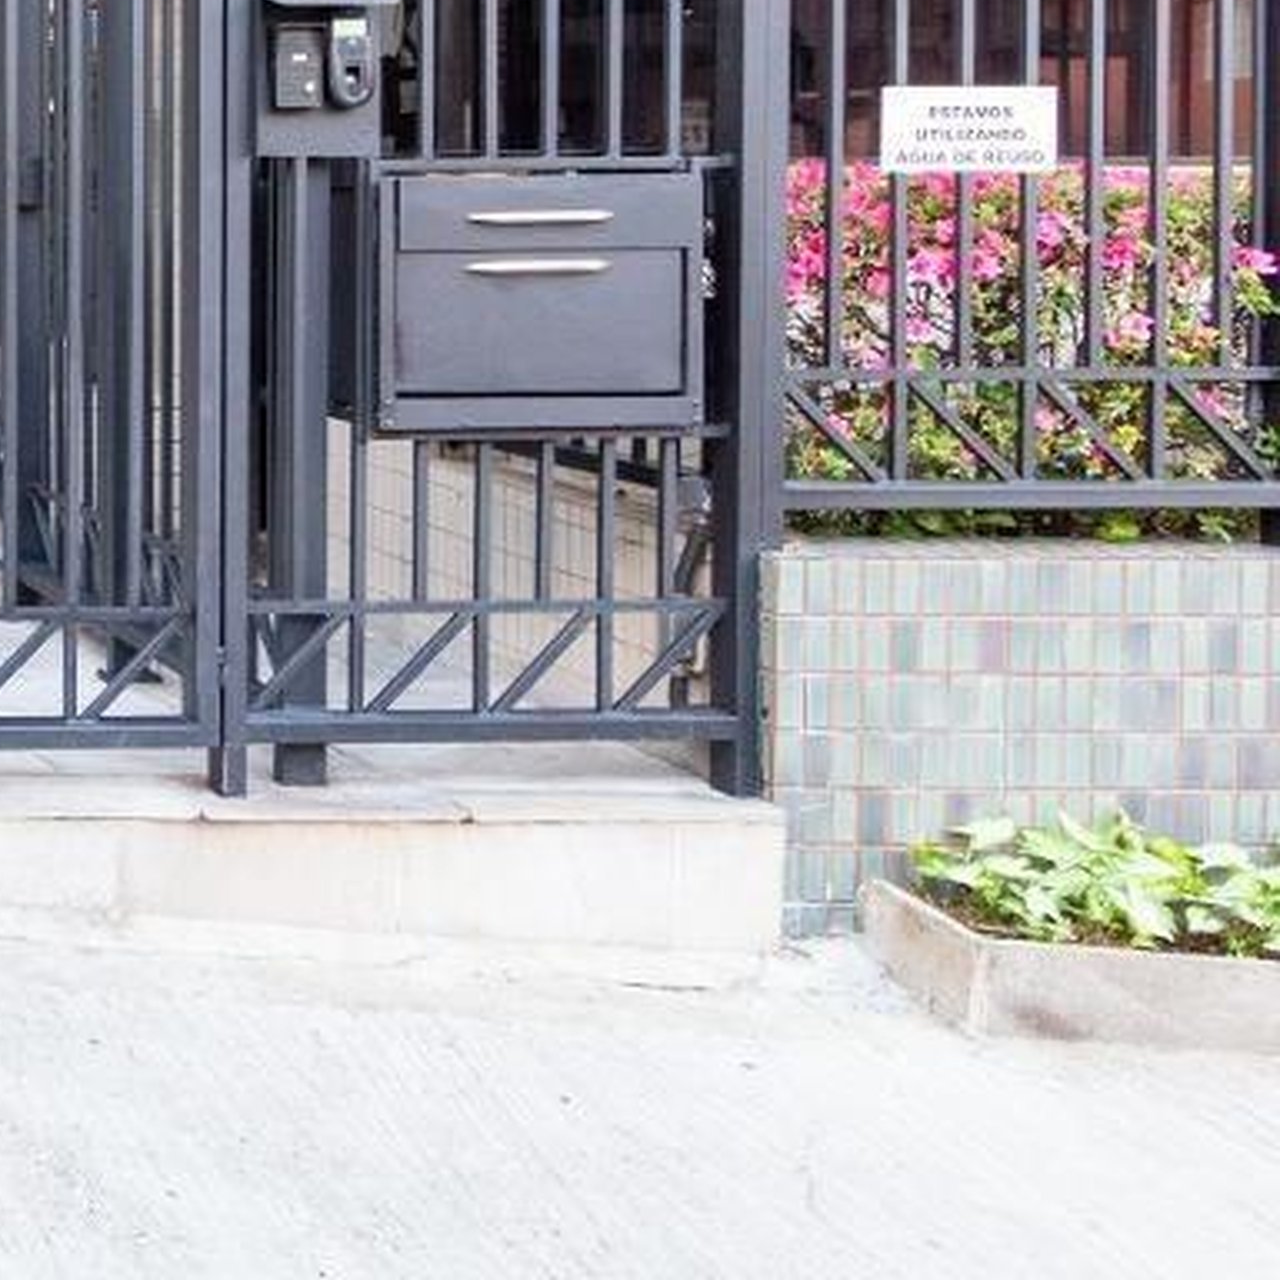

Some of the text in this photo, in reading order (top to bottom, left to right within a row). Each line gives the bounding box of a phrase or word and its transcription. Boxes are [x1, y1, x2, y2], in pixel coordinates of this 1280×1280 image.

[928, 105, 1015, 119] ESTAMOS
[915, 128, 1027, 141] UTILIZANDO
[953, 150, 977, 163] DE
[982, 150, 1045, 164] REUSO
